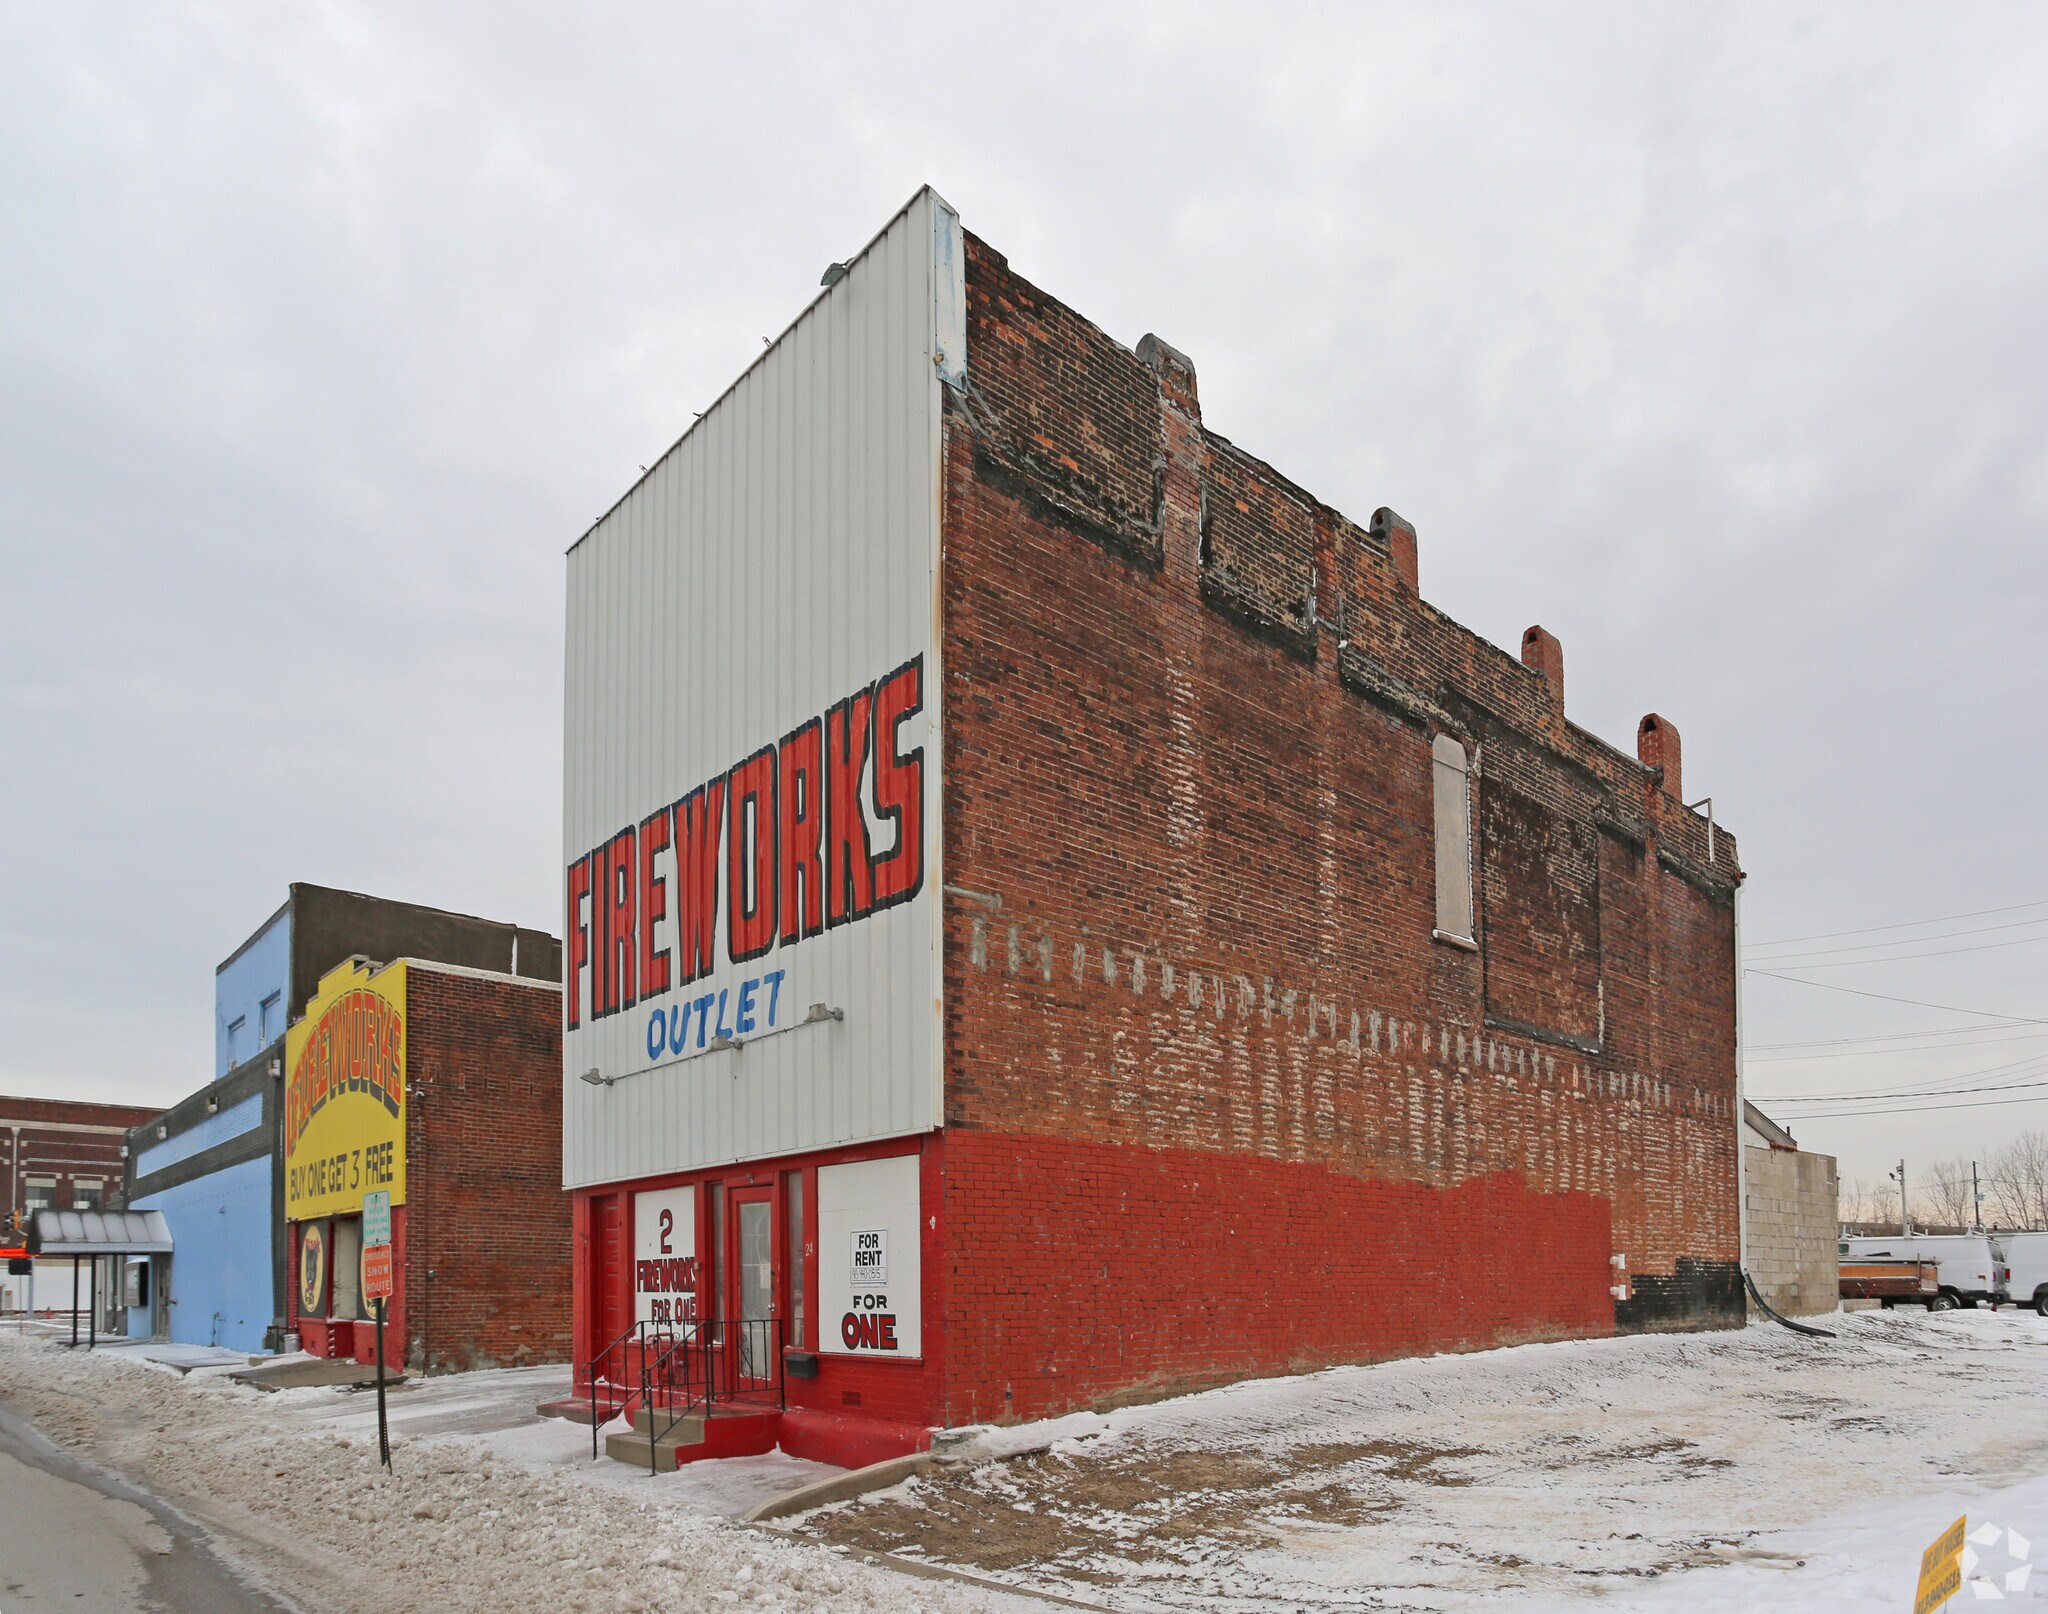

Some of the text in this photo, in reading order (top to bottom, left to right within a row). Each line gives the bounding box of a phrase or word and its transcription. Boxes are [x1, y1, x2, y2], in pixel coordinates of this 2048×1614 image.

[567, 652, 924, 1032] FIREWORKS
[647, 969, 785, 1061] OUTLET
[290, 1141, 394, 1202] BUY ONE GET 3 FREE
[659, 1208, 673, 1255] 2
[858, 1233, 879, 1249] FOR
[367, 1264, 389, 1277] SNOW
[855, 1250, 882, 1267] RENT
[366, 1280, 391, 1293] ROUTE
[853, 1293, 888, 1310] FOR
[651, 1296, 697, 1327] FOR ONE
[841, 1312, 898, 1351] ONE
